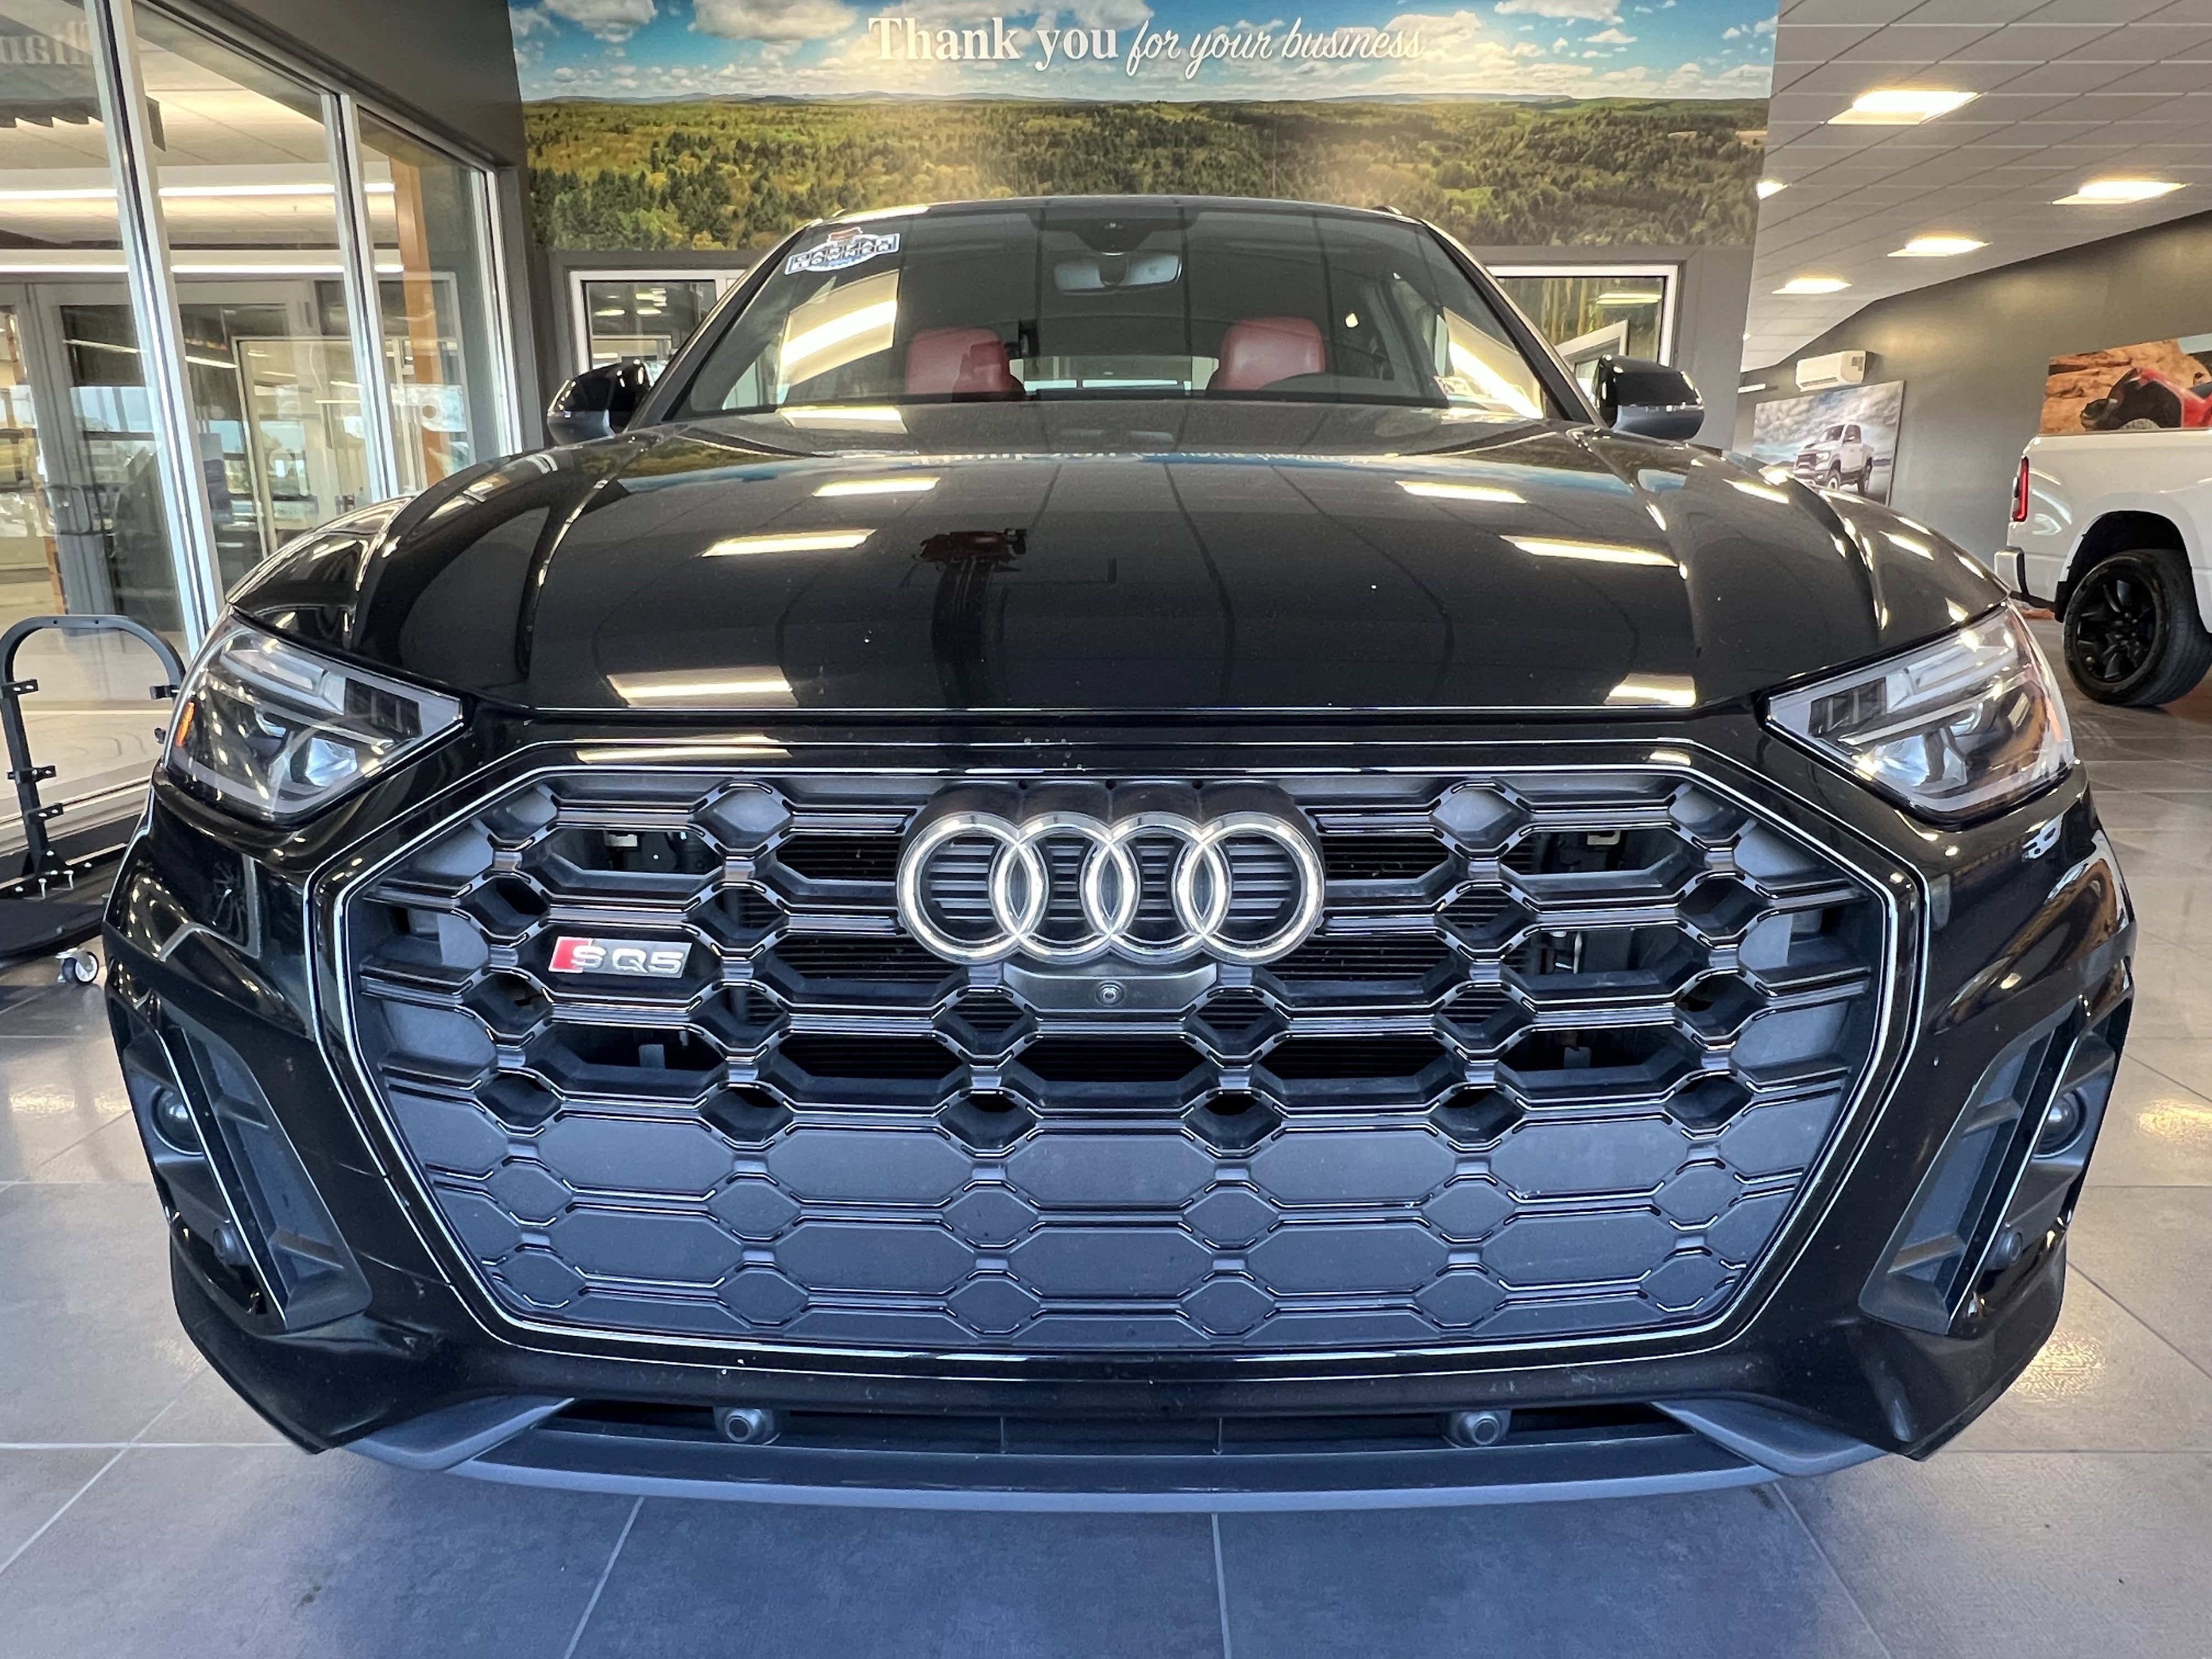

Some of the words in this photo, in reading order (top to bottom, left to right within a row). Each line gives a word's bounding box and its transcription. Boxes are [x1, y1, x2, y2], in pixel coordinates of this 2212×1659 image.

[868, 17, 1022, 60] Thank
[1035, 28, 1119, 71] you
[1126, 19, 1182, 77] for
[1185, 30, 1273, 80] your
[1282, 16, 1426, 59] business
[571, 945, 684, 974] SQ5
